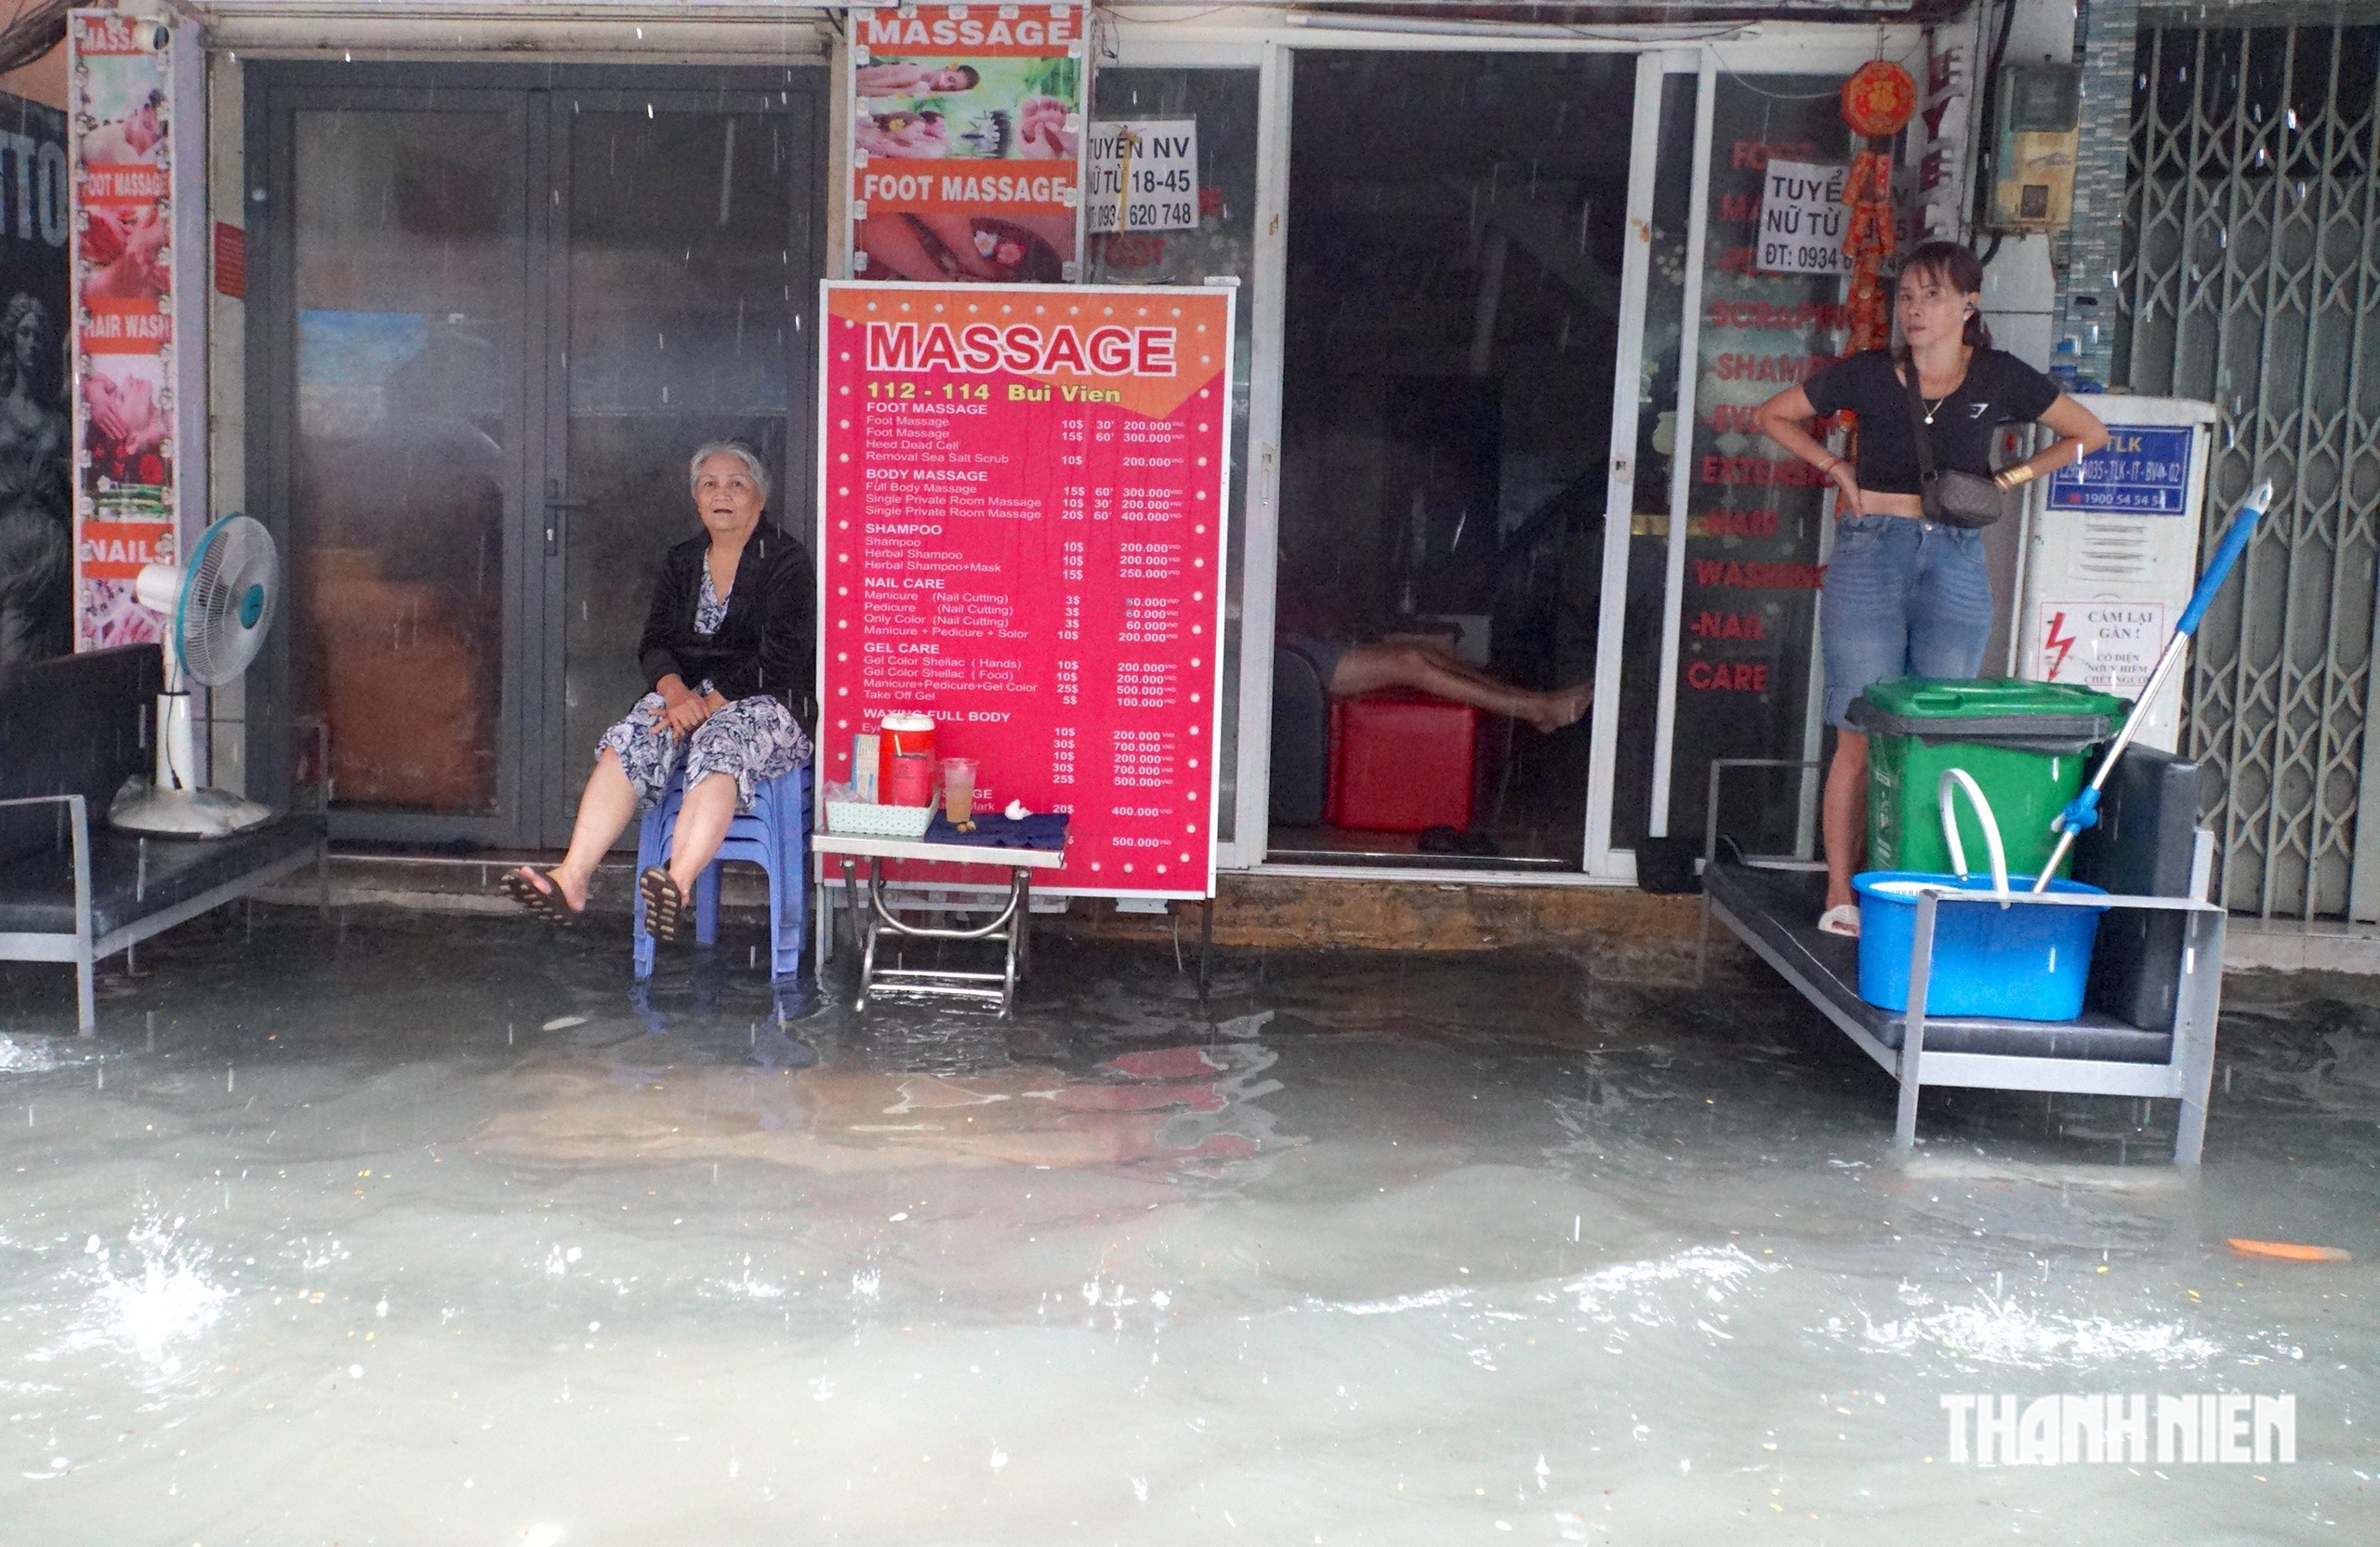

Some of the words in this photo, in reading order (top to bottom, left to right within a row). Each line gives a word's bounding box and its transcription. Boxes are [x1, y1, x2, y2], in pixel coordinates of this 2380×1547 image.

[868, 20, 1072, 46] MASSAGE
[1154, 137, 1190, 159] NV
[865, 175, 933, 202] FOOT
[942, 176, 1068, 203] MASSAGE
[1132, 169, 1191, 193] 18-45
[1772, 169, 1844, 203] TUYỂ
[1129, 204, 1157, 226] 620
[1162, 202, 1191, 225] 748
[1798, 245, 1838, 270] 0934
[866, 322, 1177, 377] MASSAGE
[866, 381, 916, 400] 112
[942, 382, 991, 401] 114
[1007, 383, 1051, 403] Bui
[1061, 385, 1120, 403] Vien
[866, 402, 908, 413] FOOT
[912, 403, 988, 416] MASSAGE
[866, 415, 892, 425] Foot
[896, 416, 949, 429] Massage
[1062, 418, 1084, 430] 10$
[866, 427, 892, 437] Foot
[896, 428, 950, 440] Massage
[1061, 430, 1084, 442] 15$
[901, 440, 932, 450] Dead
[936, 441, 959, 450] Cell
[866, 450, 918, 461] Removal
[921, 453, 945, 462] Sea
[948, 452, 972, 463] Salt
[974, 453, 1010, 464] Scrub
[1061, 455, 1084, 466] 10$
[866, 468, 909, 482] BODY
[912, 469, 988, 483] MASSAGE
[866, 481, 888, 492] Full
[890, 483, 919, 494] Body
[924, 483, 977, 496] Massage
[1064, 485, 1086, 497] 15$
[866, 494, 902, 506] Single
[905, 494, 946, 505] Private
[950, 496, 985, 506] Room
[987, 496, 1042, 509] Massage
[1063, 497, 1084, 509] 10$
[2084, 493, 2114, 505] 1900
[2117, 494, 2132, 506] 54
[2134, 495, 2149, 506] 54
[865, 505, 902, 517] Single
[906, 506, 946, 517] Private
[949, 507, 985, 517] Room
[987, 509, 1042, 522] Massage
[1061, 509, 1084, 521] 20$
[865, 522, 943, 536] SHAMPOO
[865, 536, 921, 548] Shampoo
[1064, 541, 1085, 553] 10$
[865, 548, 904, 558] Herbal
[907, 549, 963, 561] Shampoo
[1063, 555, 1084, 567] 10$
[865, 560, 904, 570] Herbal
[906, 561, 1001, 573] Shampoo+Mask
[1063, 569, 1084, 581] 15$
[864, 576, 899, 588] NAIL
[903, 577, 945, 589] CARE
[864, 589, 919, 601] Manicure
[932, 591, 959, 602] (Nail
[962, 592, 1009, 605] Cutting)
[1065, 594, 1080, 606] 3$
[864, 602, 917, 613] Pedicure
[937, 603, 964, 614] (Nail
[967, 604, 1014, 617] Cutting)
[1064, 606, 1080, 618] 3$
[863, 613, 892, 626] Only
[894, 615, 926, 624] Color
[932, 615, 959, 626] (Nail
[962, 616, 1010, 628] Cutting)
[1064, 618, 1080, 629] 3$
[864, 625, 918, 636] Manicure
[932, 626, 984, 638] Pedicure
[1057, 629, 1079, 641] 10$
[863, 641, 894, 654] GEL
[897, 642, 940, 654] CARE
[863, 654, 884, 665] Gel
[887, 655, 918, 666] Color
[922, 656, 965, 668] Shellac
[1057, 660, 1079, 671] 10$
[863, 666, 884, 676] Gel
[887, 667, 919, 677] Color
[922, 668, 964, 679] Shellac
[1056, 671, 1078, 682] 10$
[1686, 661, 1769, 693] CARE
[1005, 681, 1039, 693] Color
[1056, 683, 1079, 694] 25$
[864, 689, 891, 699] Take
[893, 691, 912, 700] Off
[915, 691, 935, 701] Gel
[1062, 694, 1078, 706] 5$
[928, 709, 965, 722] FULL
[967, 710, 1012, 723] BODY
[1053, 726, 1076, 737] 10$
[1053, 738, 1076, 750] 30$
[1053, 750, 1076, 761] 10$
[1051, 762, 1075, 774] 30$
[1052, 774, 1076, 785] 25$
[1052, 803, 1075, 815] 20$
